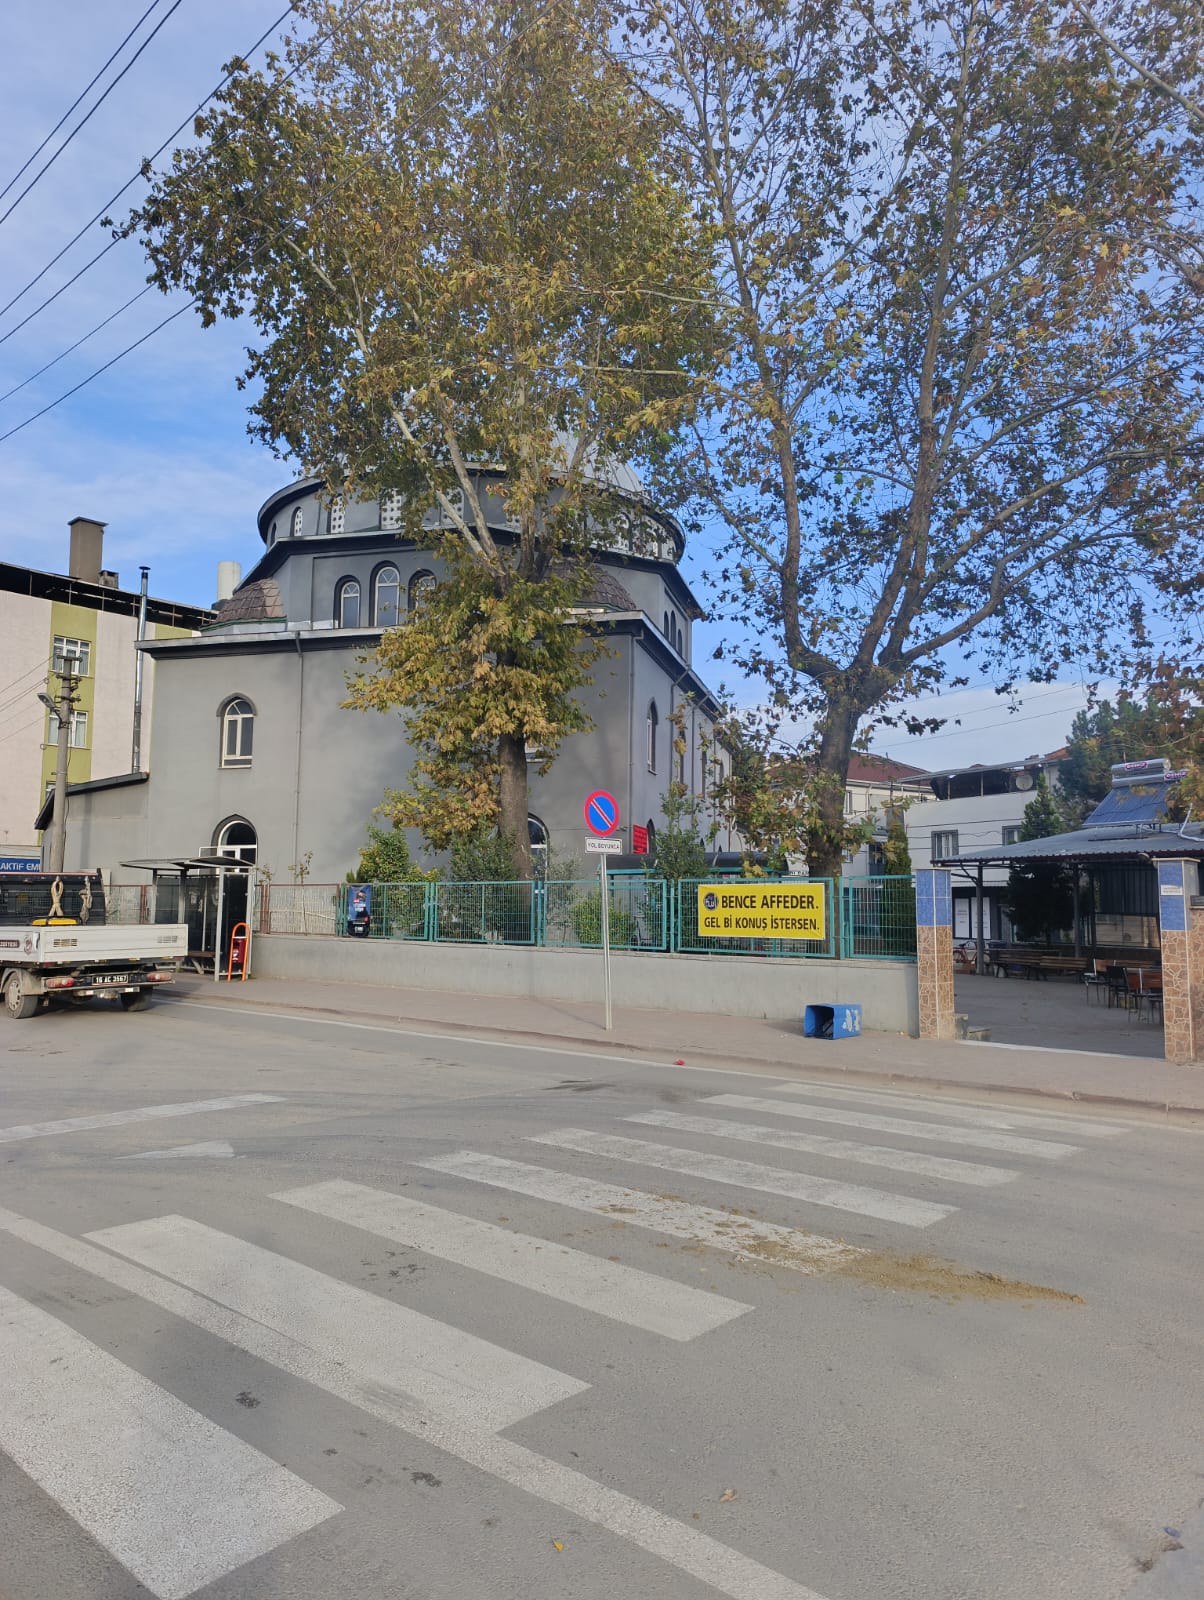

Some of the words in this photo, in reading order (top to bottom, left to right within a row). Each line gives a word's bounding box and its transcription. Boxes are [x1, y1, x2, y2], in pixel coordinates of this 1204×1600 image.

[721, 895, 757, 909] BENCE
[760, 895, 819, 910] AFFEDER.
[704, 917, 721, 928] GEL
[723, 914, 733, 929] Bİ
[735, 917, 768, 931] KONUŞ
[770, 915, 820, 930] İSTERSEN.
